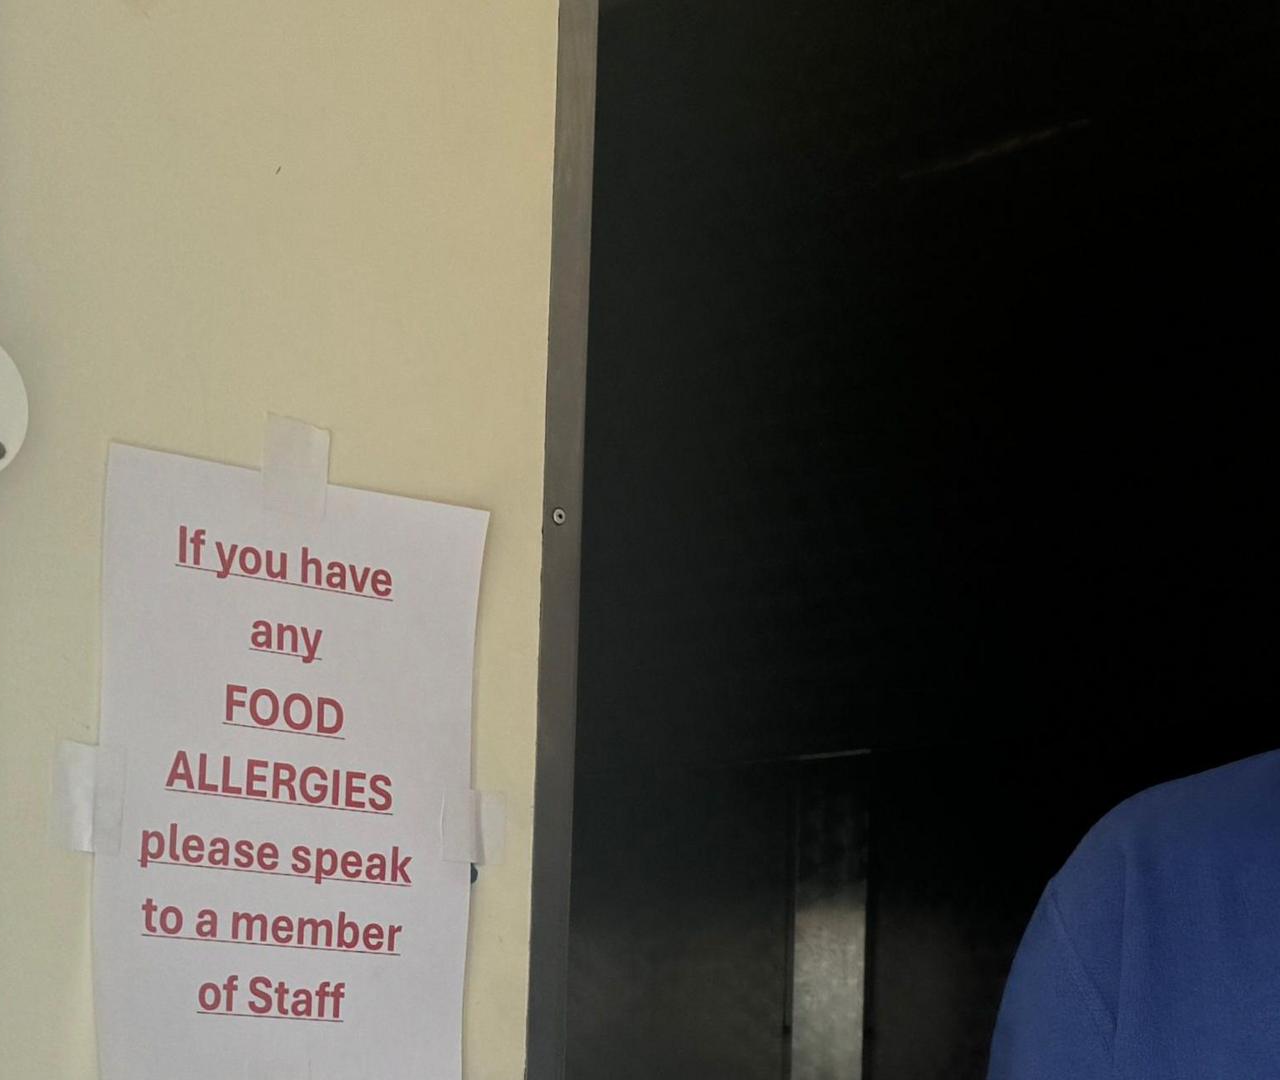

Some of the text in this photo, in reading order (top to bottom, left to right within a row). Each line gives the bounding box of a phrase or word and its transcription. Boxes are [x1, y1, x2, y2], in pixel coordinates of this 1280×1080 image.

[177, 525, 393, 597] If you have
[250, 618, 323, 663] any
[225, 685, 345, 736] FOOD
[166, 750, 393, 812] ALLERGIES
[138, 824, 412, 885] please speak
[141, 898, 402, 952] to a member
[197, 975, 345, 1019] of Staff
